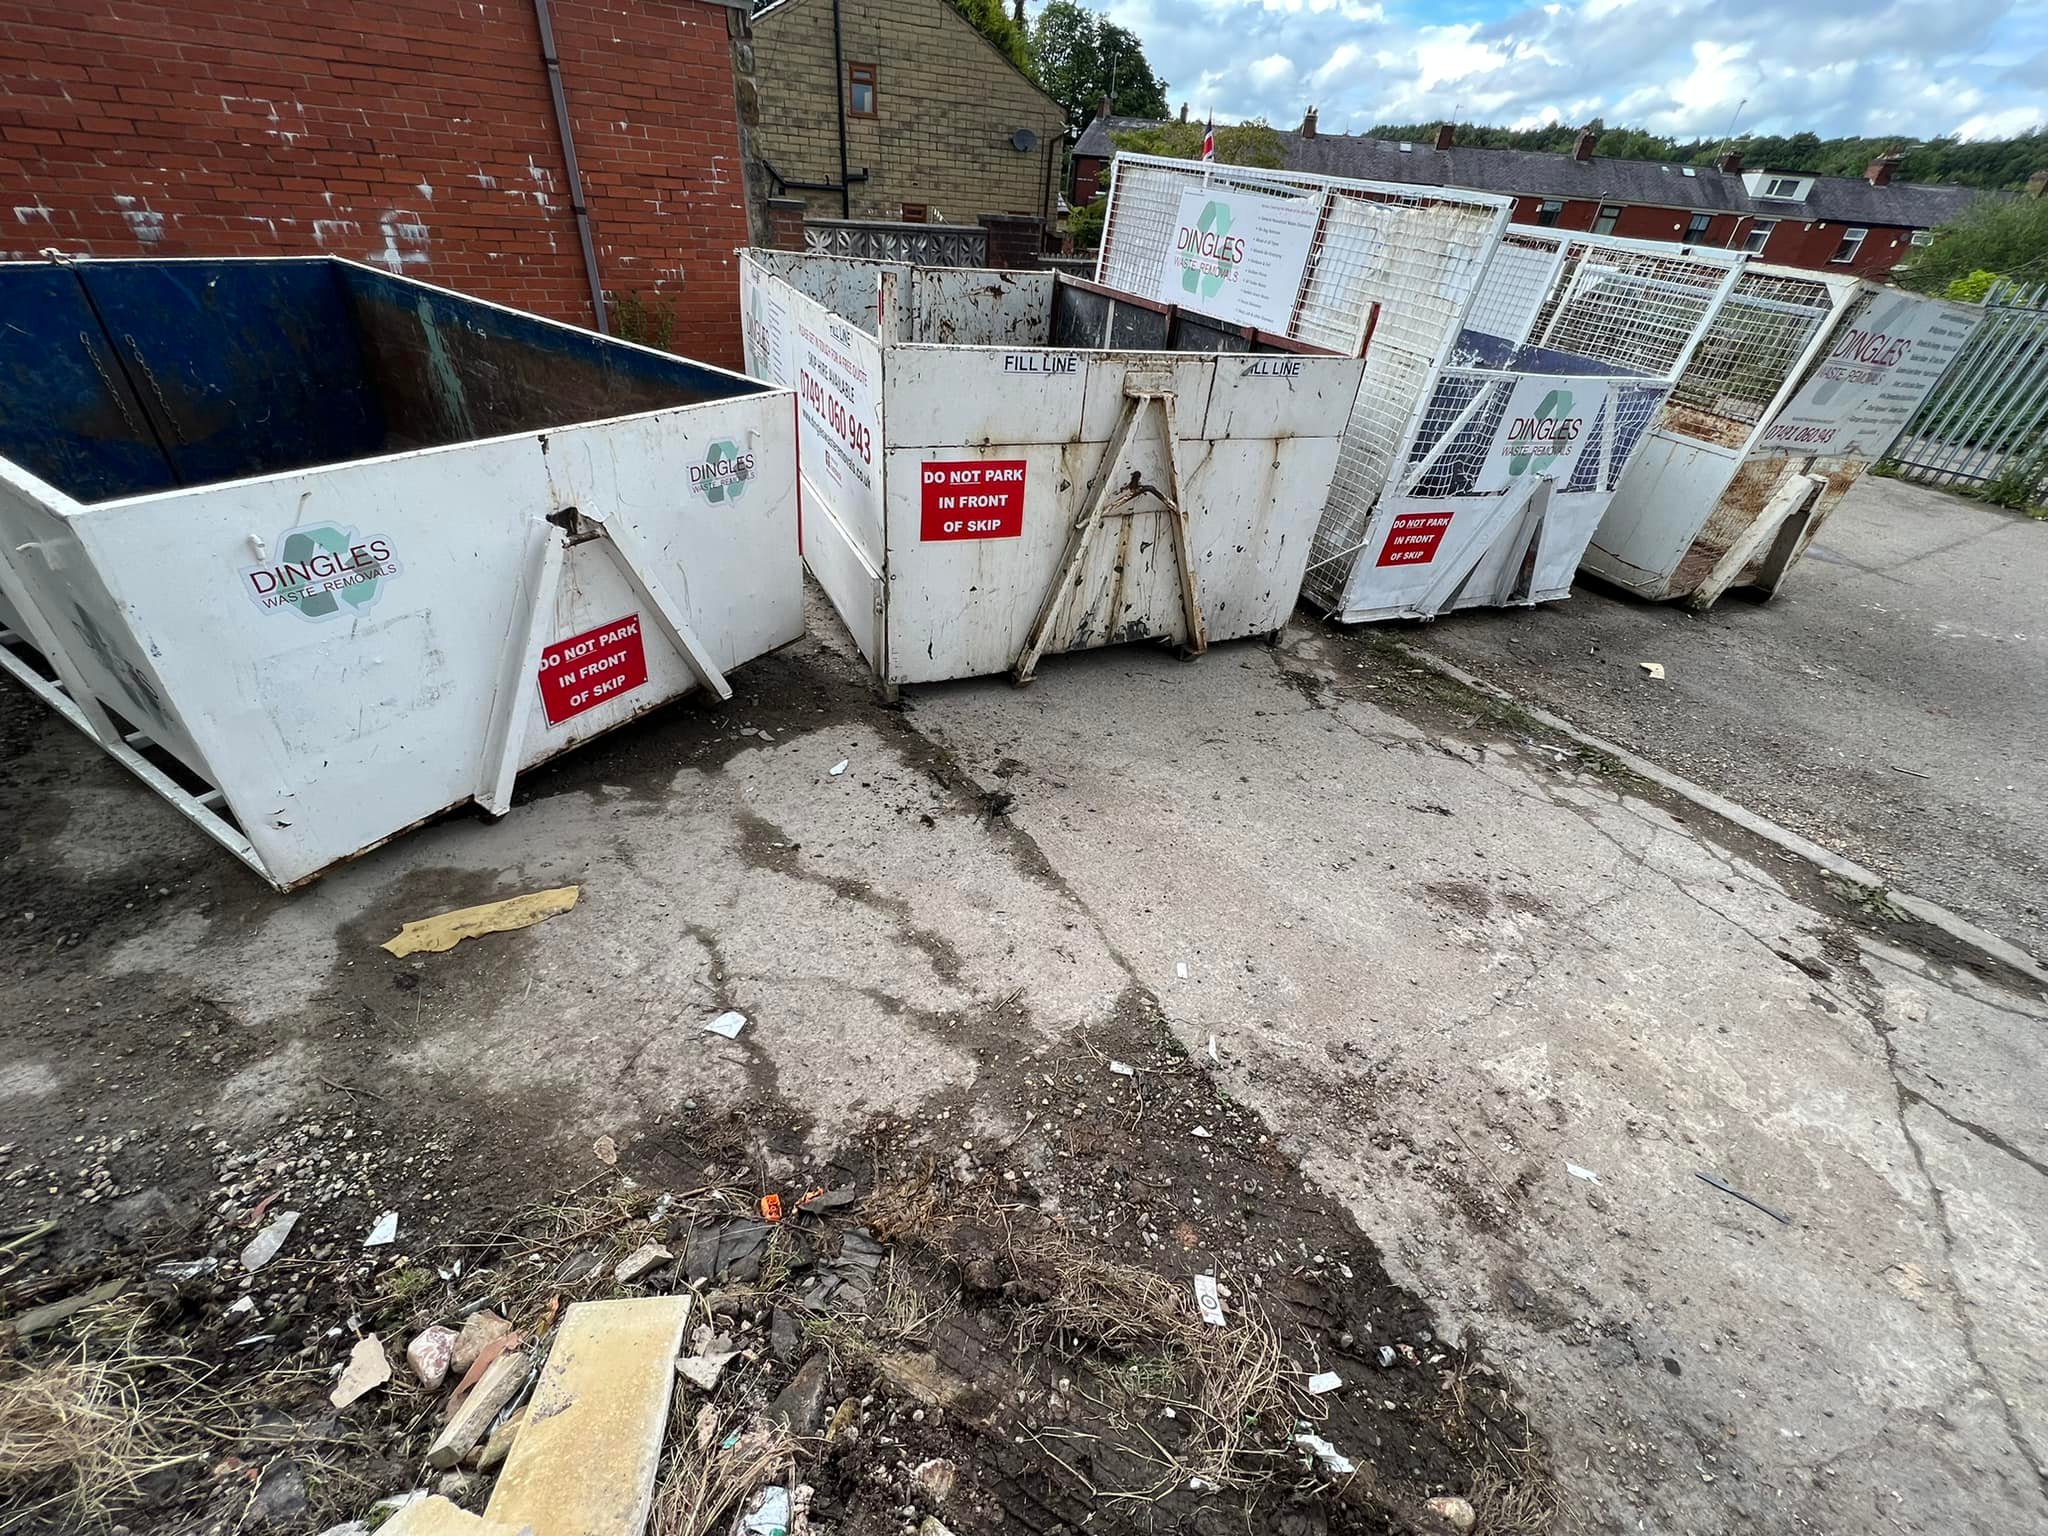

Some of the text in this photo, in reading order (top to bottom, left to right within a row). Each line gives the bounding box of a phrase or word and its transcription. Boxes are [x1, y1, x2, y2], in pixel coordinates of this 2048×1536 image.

[1177, 227, 1245, 264] DINGLES
[1174, 257, 1196, 271] WASTE
[1200, 261, 1240, 283] REMOVALS
[1832, 329, 1911, 367] DINGLES
[1004, 355, 1076, 373] FILL LINE
[1249, 361, 1301, 375] ILL LINE
[800, 367, 871, 465] 07491 060 943
[1508, 418, 1583, 440] DINGLES
[1502, 446, 1572, 456] WASTE REMOVALS
[690, 454, 754, 482] DINGLES
[924, 469, 1024, 485] DO NOT PARK
[692, 481, 717, 494] WASTE
[939, 494, 1009, 509] IN FRONT
[943, 519, 1001, 533] OF SKIP
[1393, 518, 1450, 529] DO NOT PARK
[1393, 535, 1435, 545] IN FRONT
[250, 540, 390, 594] DINGLES
[1390, 551, 1424, 561] OF SKIP
[262, 564, 397, 609] WASTE REMOVALS
[540, 623, 638, 672] DO NOT PARK
[559, 650, 627, 688] IN FRONT
[570, 675, 626, 707] OF SKIP
